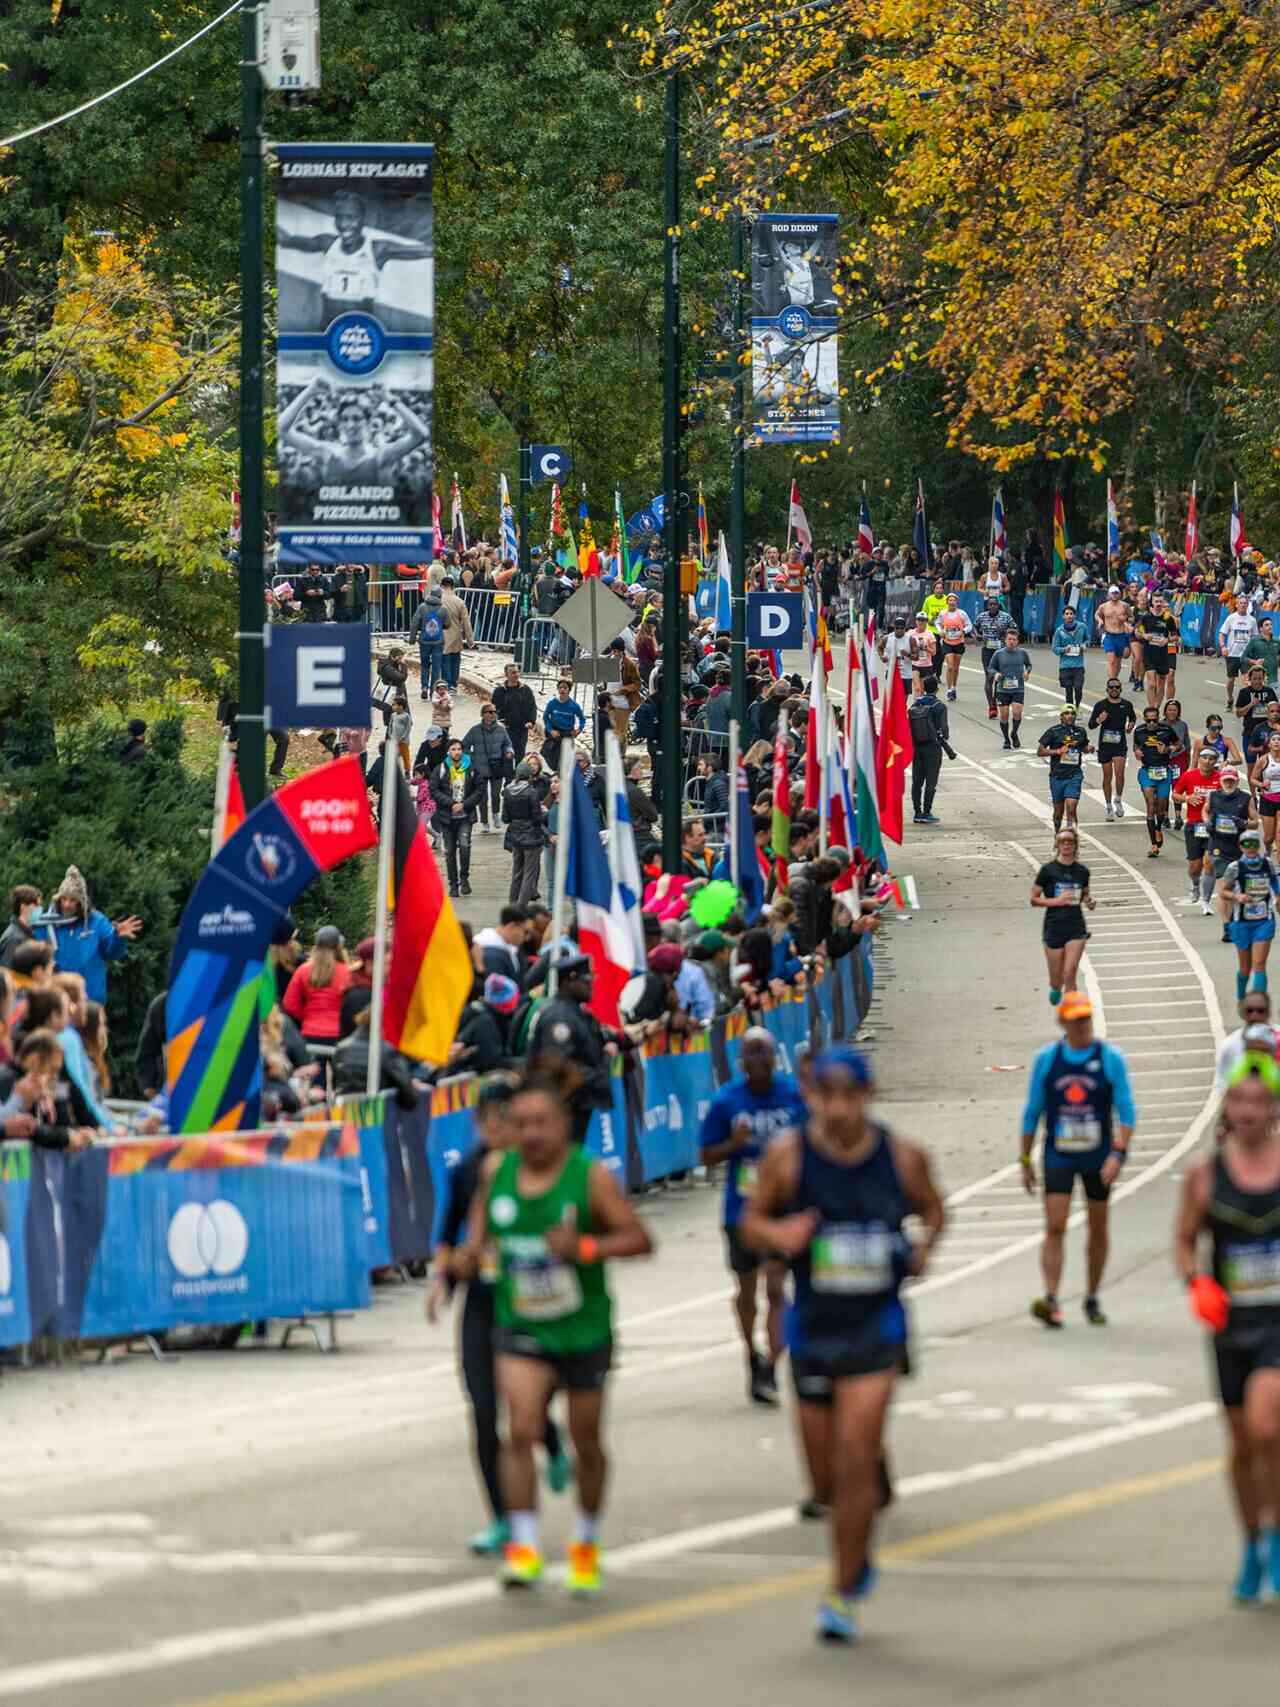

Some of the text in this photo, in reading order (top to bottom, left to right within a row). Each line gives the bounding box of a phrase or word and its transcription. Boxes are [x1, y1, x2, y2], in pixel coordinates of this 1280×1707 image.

[281, 162, 428, 177] LORNAH KIPLAGAT
[771, 224, 818, 232] ROD DIXON
[540, 452, 561, 475] C
[318, 485, 394, 501] ORLANDO
[313, 505, 401, 521] PIZZOLATO
[760, 605, 790, 637] D
[296, 645, 346, 707] E
